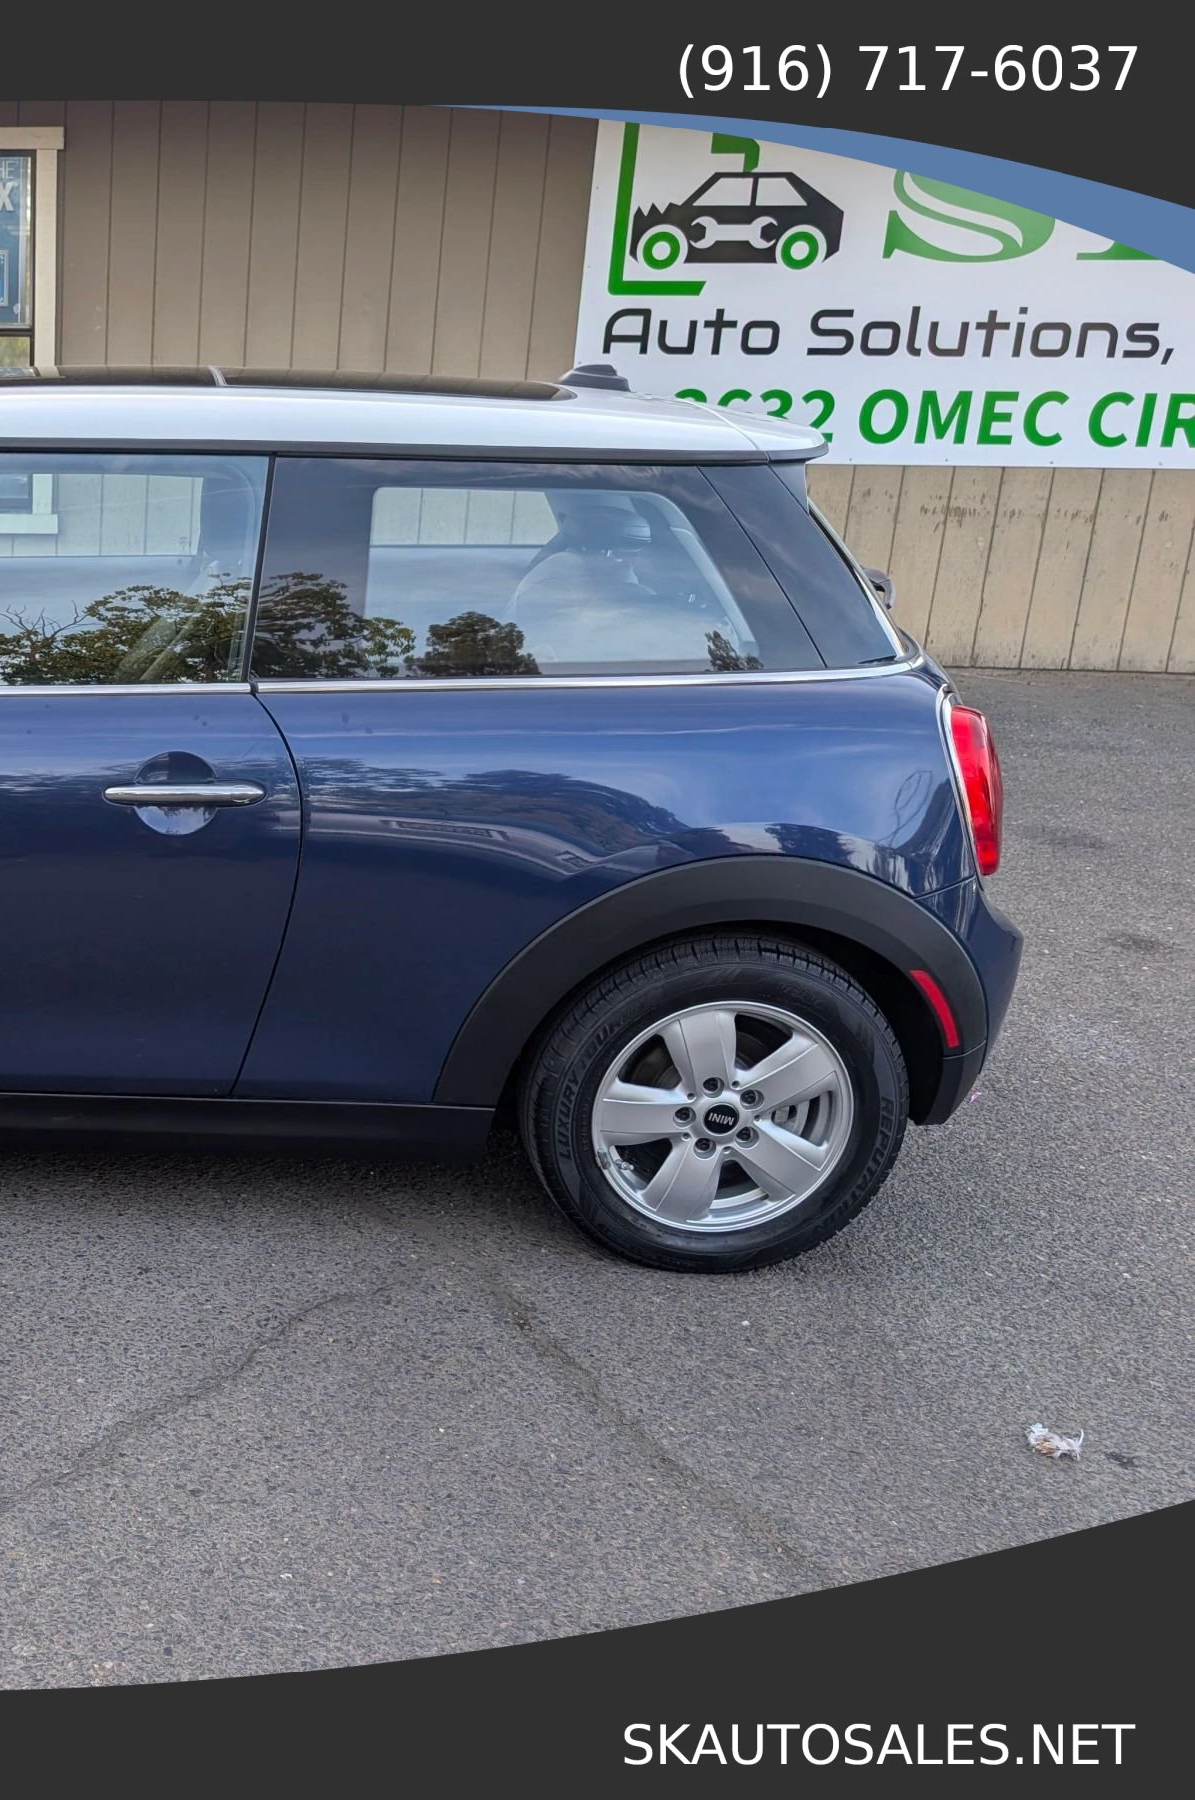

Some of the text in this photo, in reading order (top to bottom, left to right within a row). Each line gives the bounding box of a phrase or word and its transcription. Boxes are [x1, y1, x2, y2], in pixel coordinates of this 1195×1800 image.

[602, 306, 1174, 365] Auto Solutions,
[674, 388, 1195, 448] 32 OMEC CIR
[557, 1069, 580, 1160] LUXURY
[708, 1112, 735, 1126] MINI
